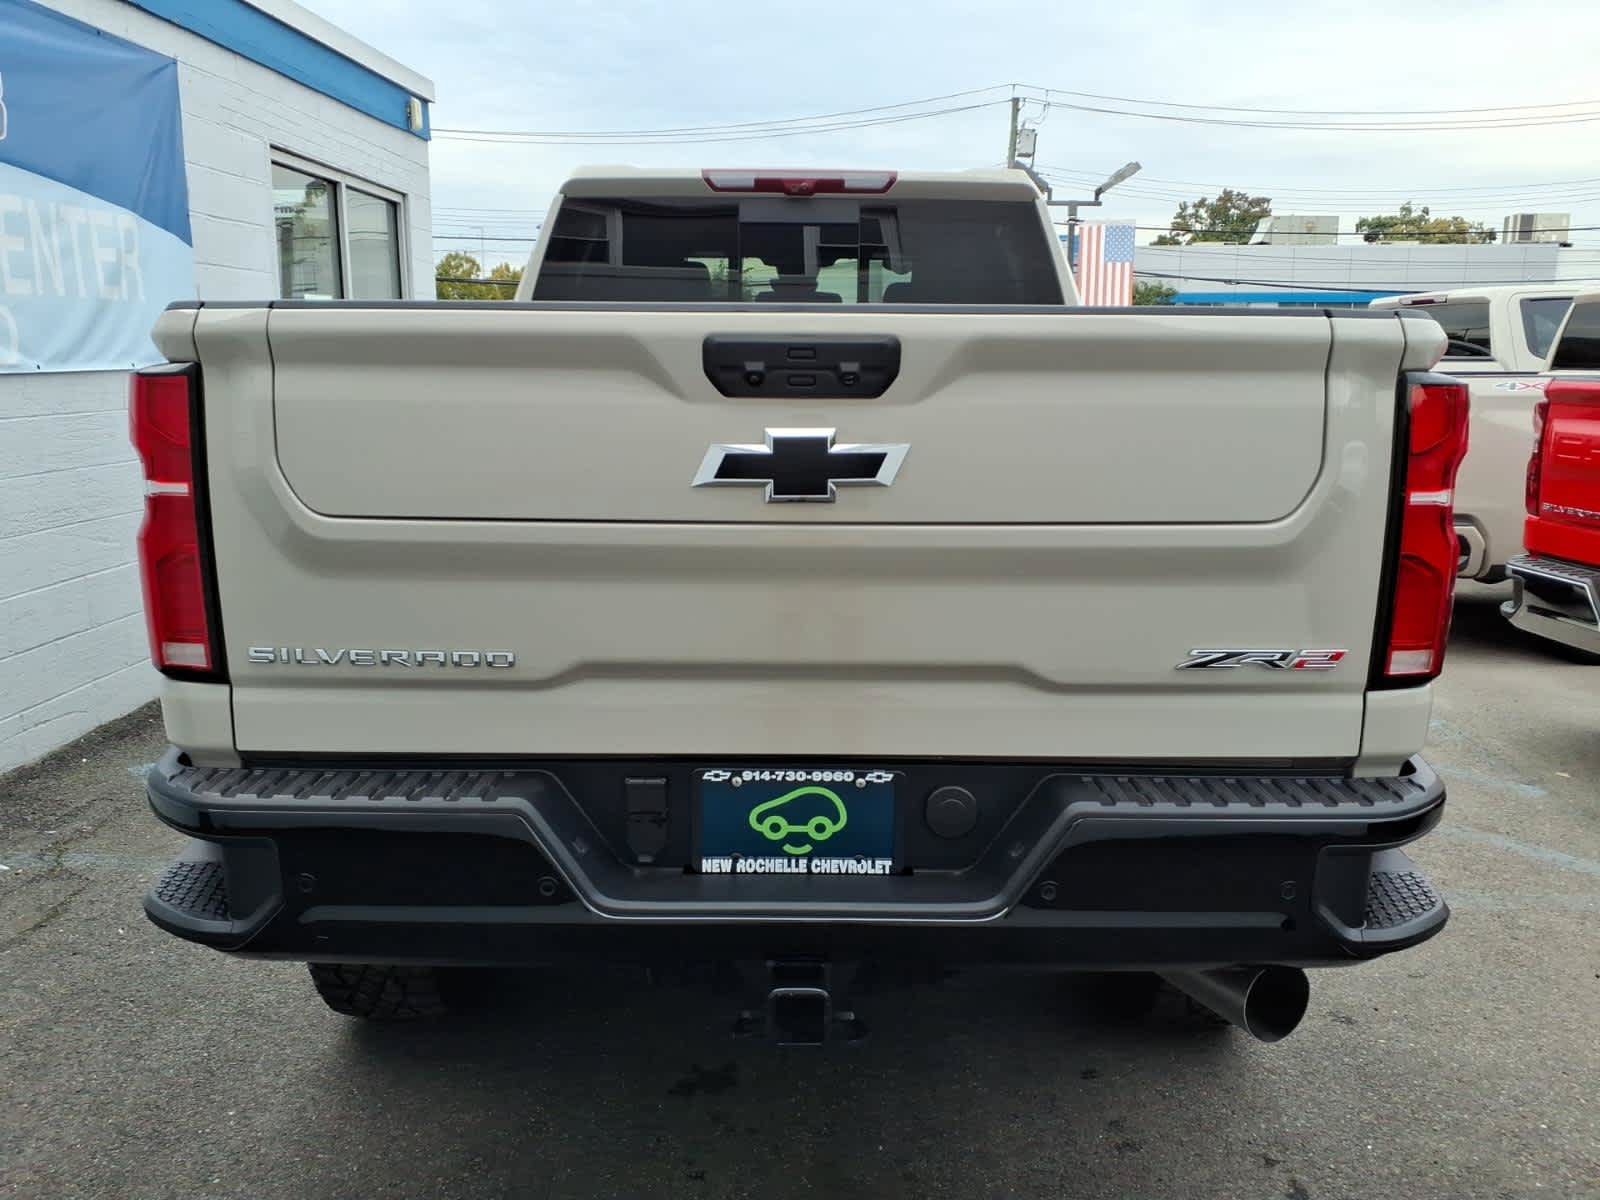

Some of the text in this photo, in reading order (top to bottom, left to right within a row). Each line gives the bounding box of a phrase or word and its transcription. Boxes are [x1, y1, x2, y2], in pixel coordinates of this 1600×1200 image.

[248, 646, 516, 668] SILVERADO
[1175, 649, 1349, 671] ZR2
[741, 770, 855, 782] 914-730-9960
[701, 858, 893, 875] NEW ROCHELLE CHEVROLET
